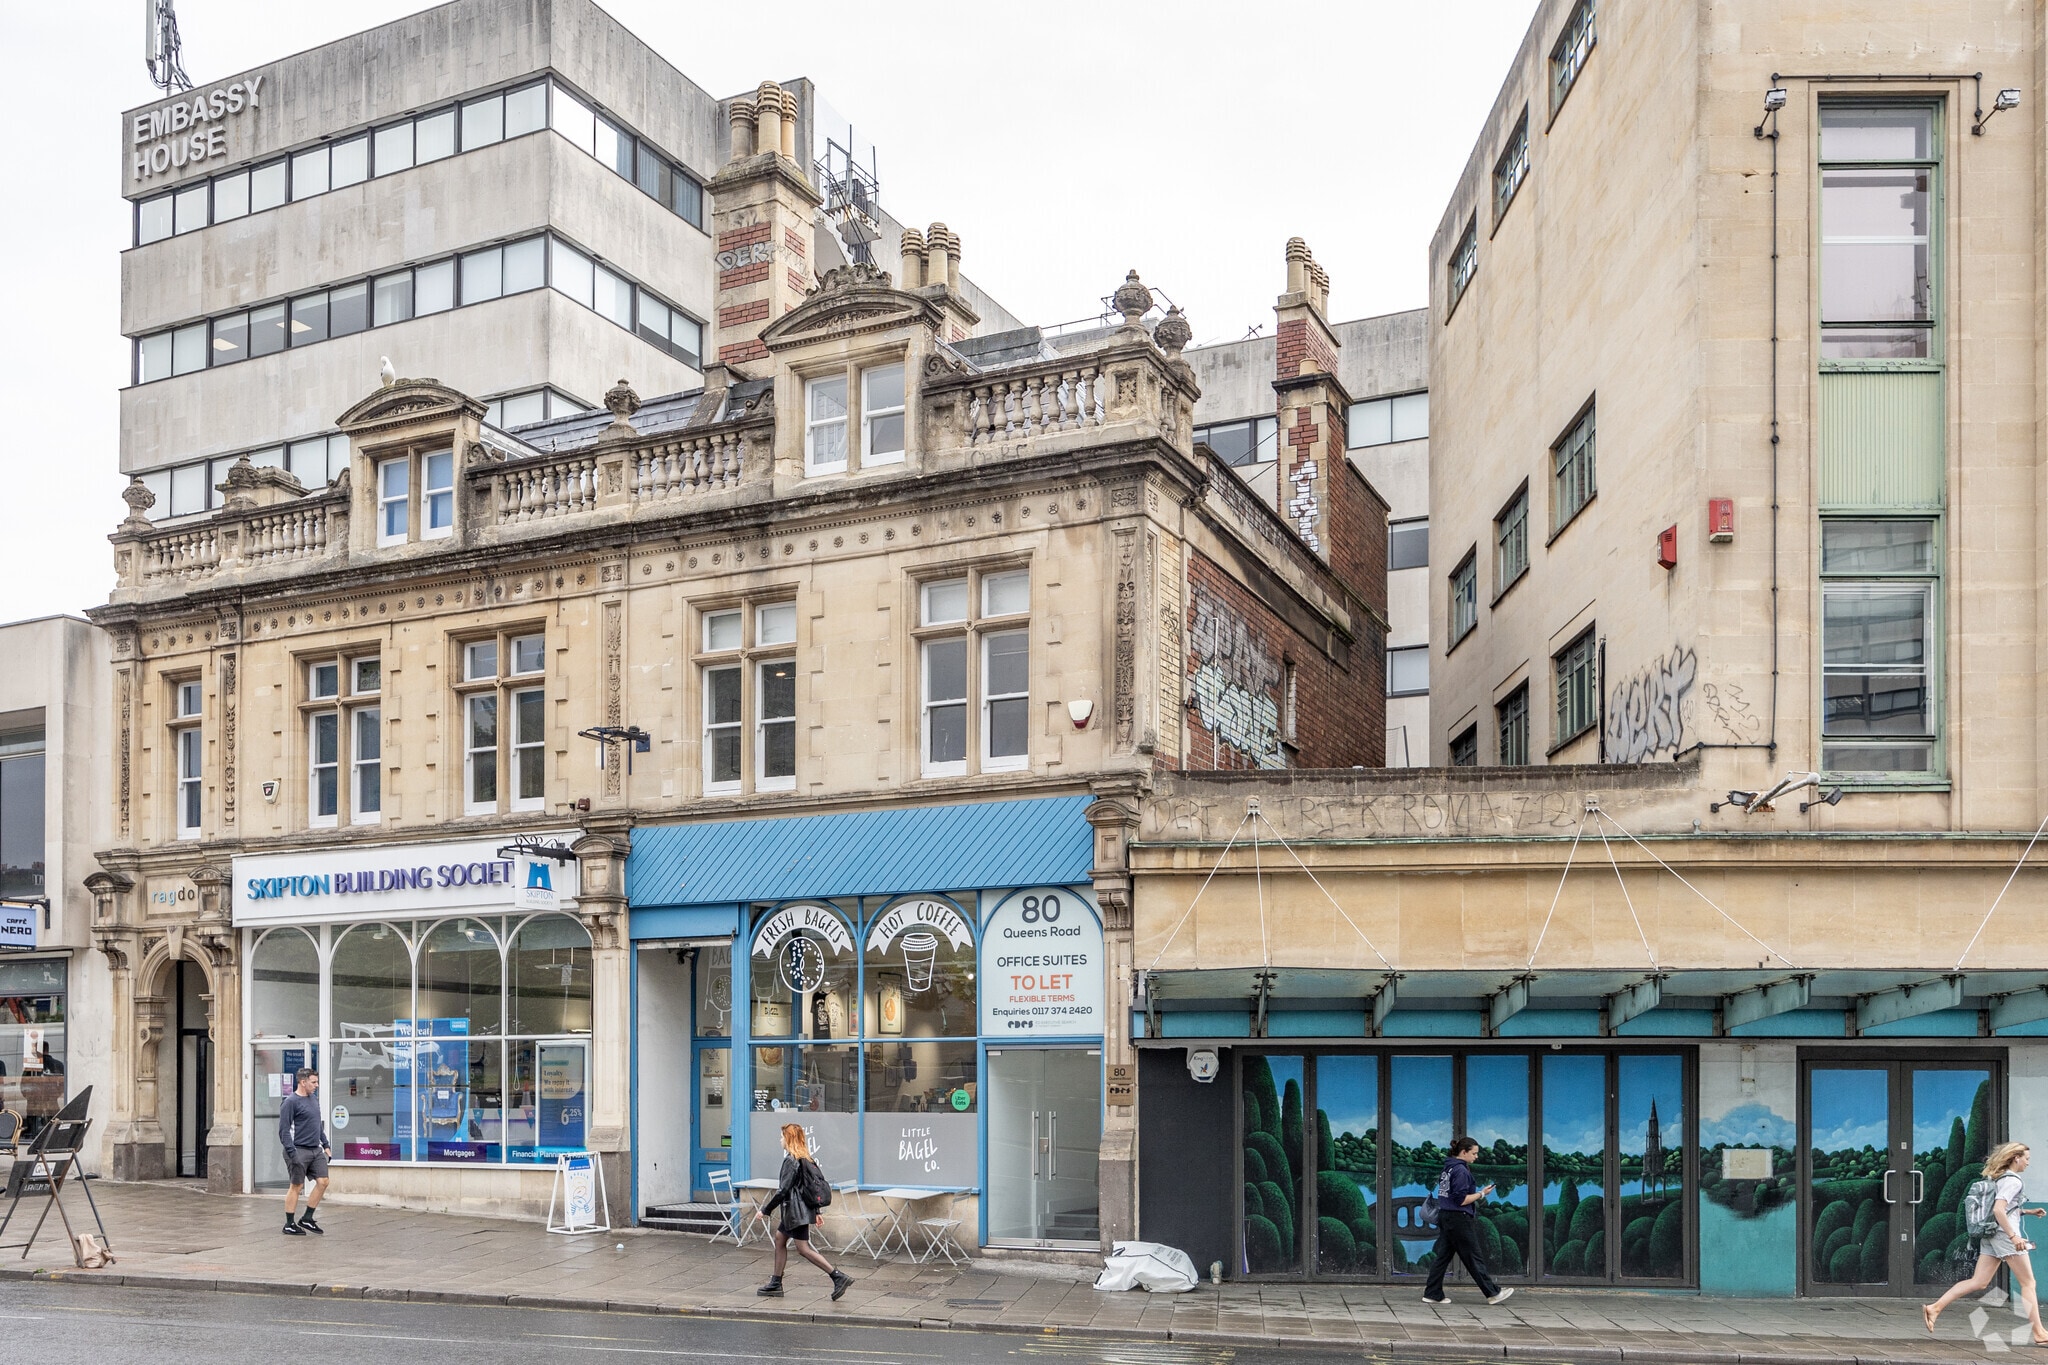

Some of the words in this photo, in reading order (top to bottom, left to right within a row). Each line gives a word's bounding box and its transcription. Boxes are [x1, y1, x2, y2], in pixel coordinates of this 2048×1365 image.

[134, 76, 265, 144] EMBASSY
[134, 125, 227, 181] HOUSE
[247, 873, 330, 900] SKIPTON
[334, 865, 433, 895] BUILDING
[436, 860, 515, 888] SOCIET
[526, 890, 554, 899] SKIPTON
[1021, 895, 1061, 923] 80
[761, 911, 795, 946] FRESH
[804, 908, 845, 944] BAGELS
[879, 909, 904, 939] HOT
[916, 902, 962, 937] COFFEE
[1, 926, 32, 936] NERO
[1003, 927, 1048, 939] Queens
[1050, 926, 1081, 937] Road
[997, 956, 1040, 968] OFFICE
[1042, 954, 1087, 966] SUITES
[1011, 975, 1036, 991] TO
[1039, 974, 1073, 990] LET
[1009, 995, 1046, 1003] FLEXIBLE
[1048, 994, 1075, 1002] TERMS
[992, 1007, 1030, 1017] Enquiries
[1031, 1007, 1050, 1015] 0117
[1051, 1007, 1067, 1015] 374
[1068, 1006, 1093, 1015] 2420
[1113, 1068, 1126, 1077] 80
[901, 1127, 931, 1138] LITTLE
[360, 1147, 382, 1157] Savings
[443, 1149, 475, 1158] Mortgages
[511, 1150, 538, 1158] Financial
[898, 1138, 938, 1161] BAGEL
[924, 1159, 940, 1173] CO.
